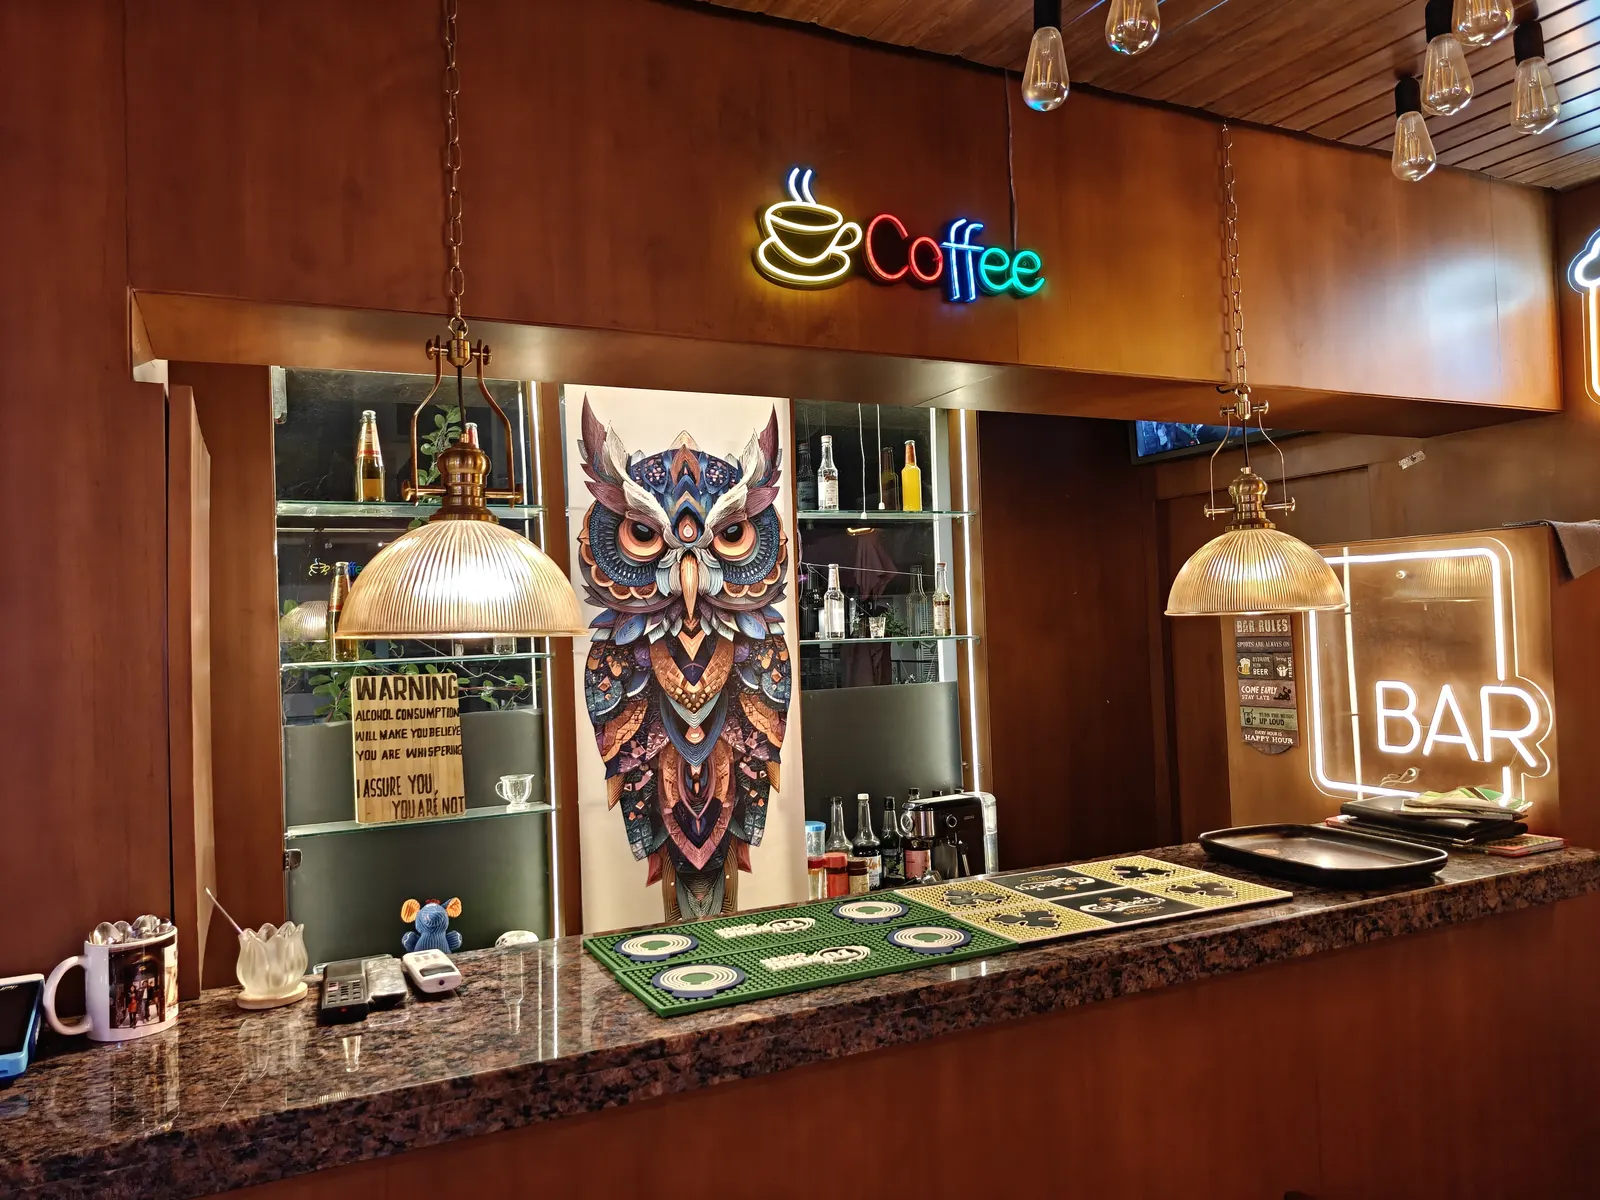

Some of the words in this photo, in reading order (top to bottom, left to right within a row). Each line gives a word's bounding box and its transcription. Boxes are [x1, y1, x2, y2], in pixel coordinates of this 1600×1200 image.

[865, 214, 1045, 302] Coffee
[1236, 620, 1255, 633] BAR
[1259, 619, 1288, 633] RULES
[1252, 668, 1269, 676] BEER
[356, 674, 459, 701] WARNING
[1241, 685, 1260, 694] COME
[1261, 686, 1277, 695] EARLY
[355, 708, 394, 721] ALCOHOL
[395, 707, 460, 720] CONSUMPTION
[1375, 680, 1540, 768] BAR
[355, 730, 377, 741] WILL
[379, 728, 408, 741] MAKE
[410, 727, 428, 739] YOU
[429, 725, 461, 738] BELIEVE
[1245, 734, 1270, 742] HAPPY
[1272, 736, 1294, 744] HOUR
[356, 750, 377, 761] YOU
[381, 748, 400, 760] ARE
[406, 745, 463, 759] WHISPERING
[357, 778, 360, 799] I
[363, 776, 402, 798] ASSURE
[392, 799, 415, 819] YOU
[417, 798, 439, 816] ARE
[442, 796, 465, 815] NOT
